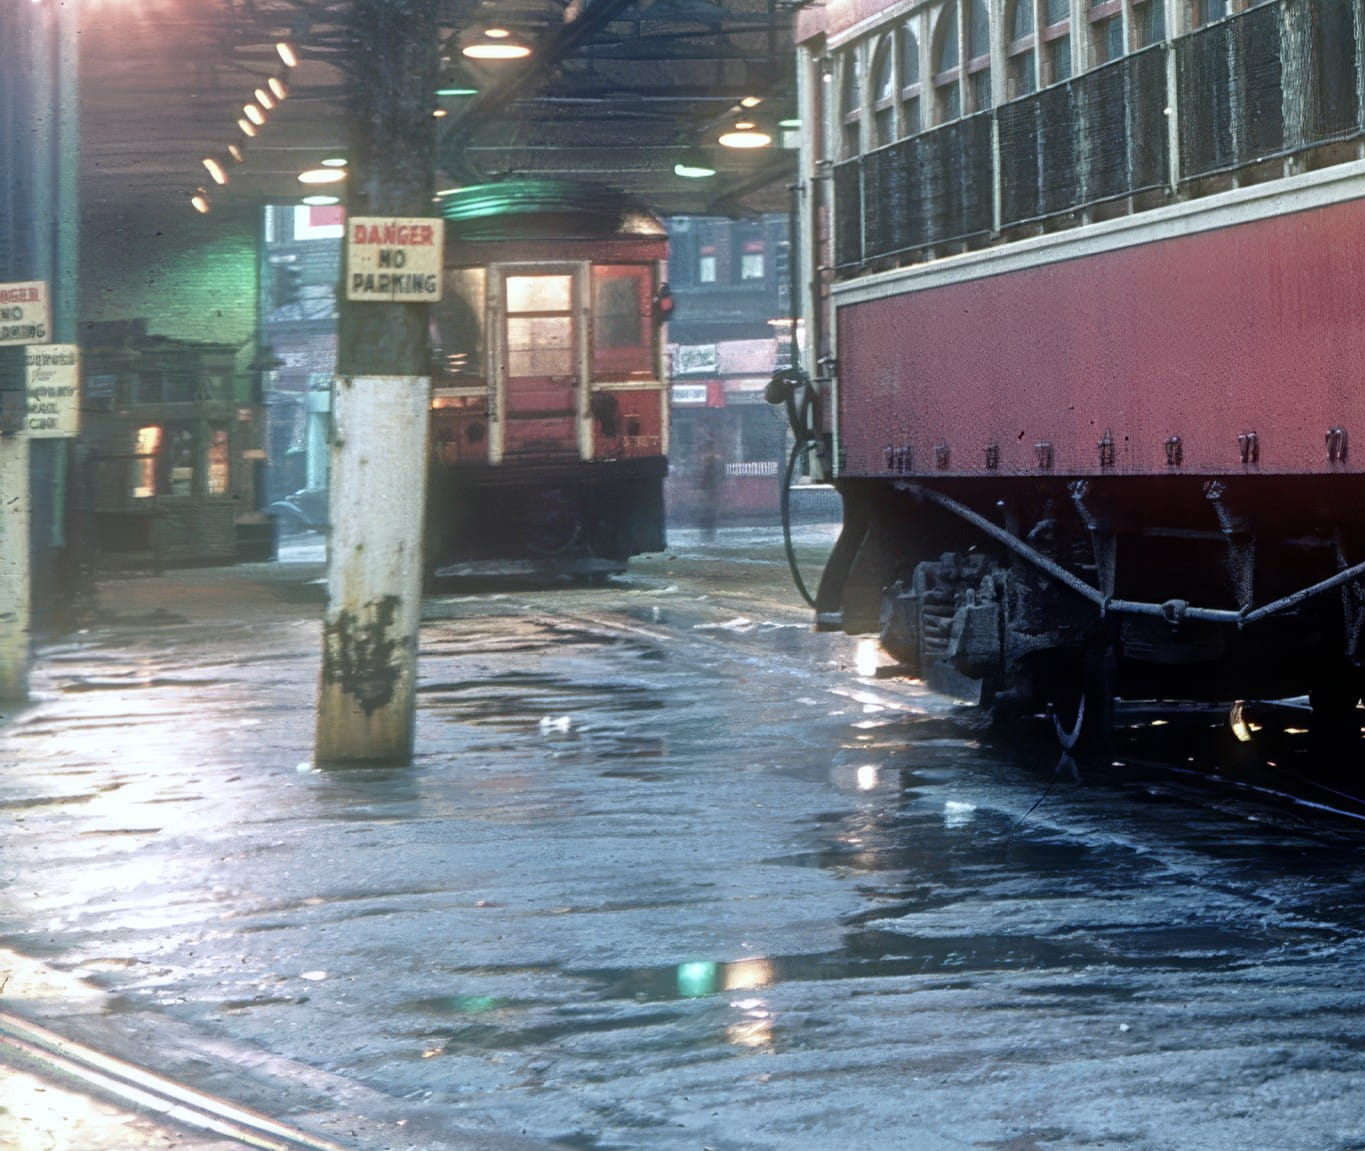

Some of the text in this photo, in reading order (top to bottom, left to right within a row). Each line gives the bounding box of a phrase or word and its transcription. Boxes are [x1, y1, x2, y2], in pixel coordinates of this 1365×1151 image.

[353, 224, 435, 246] DANGER
[378, 249, 406, 269] NO
[352, 273, 437, 294] PARKING
